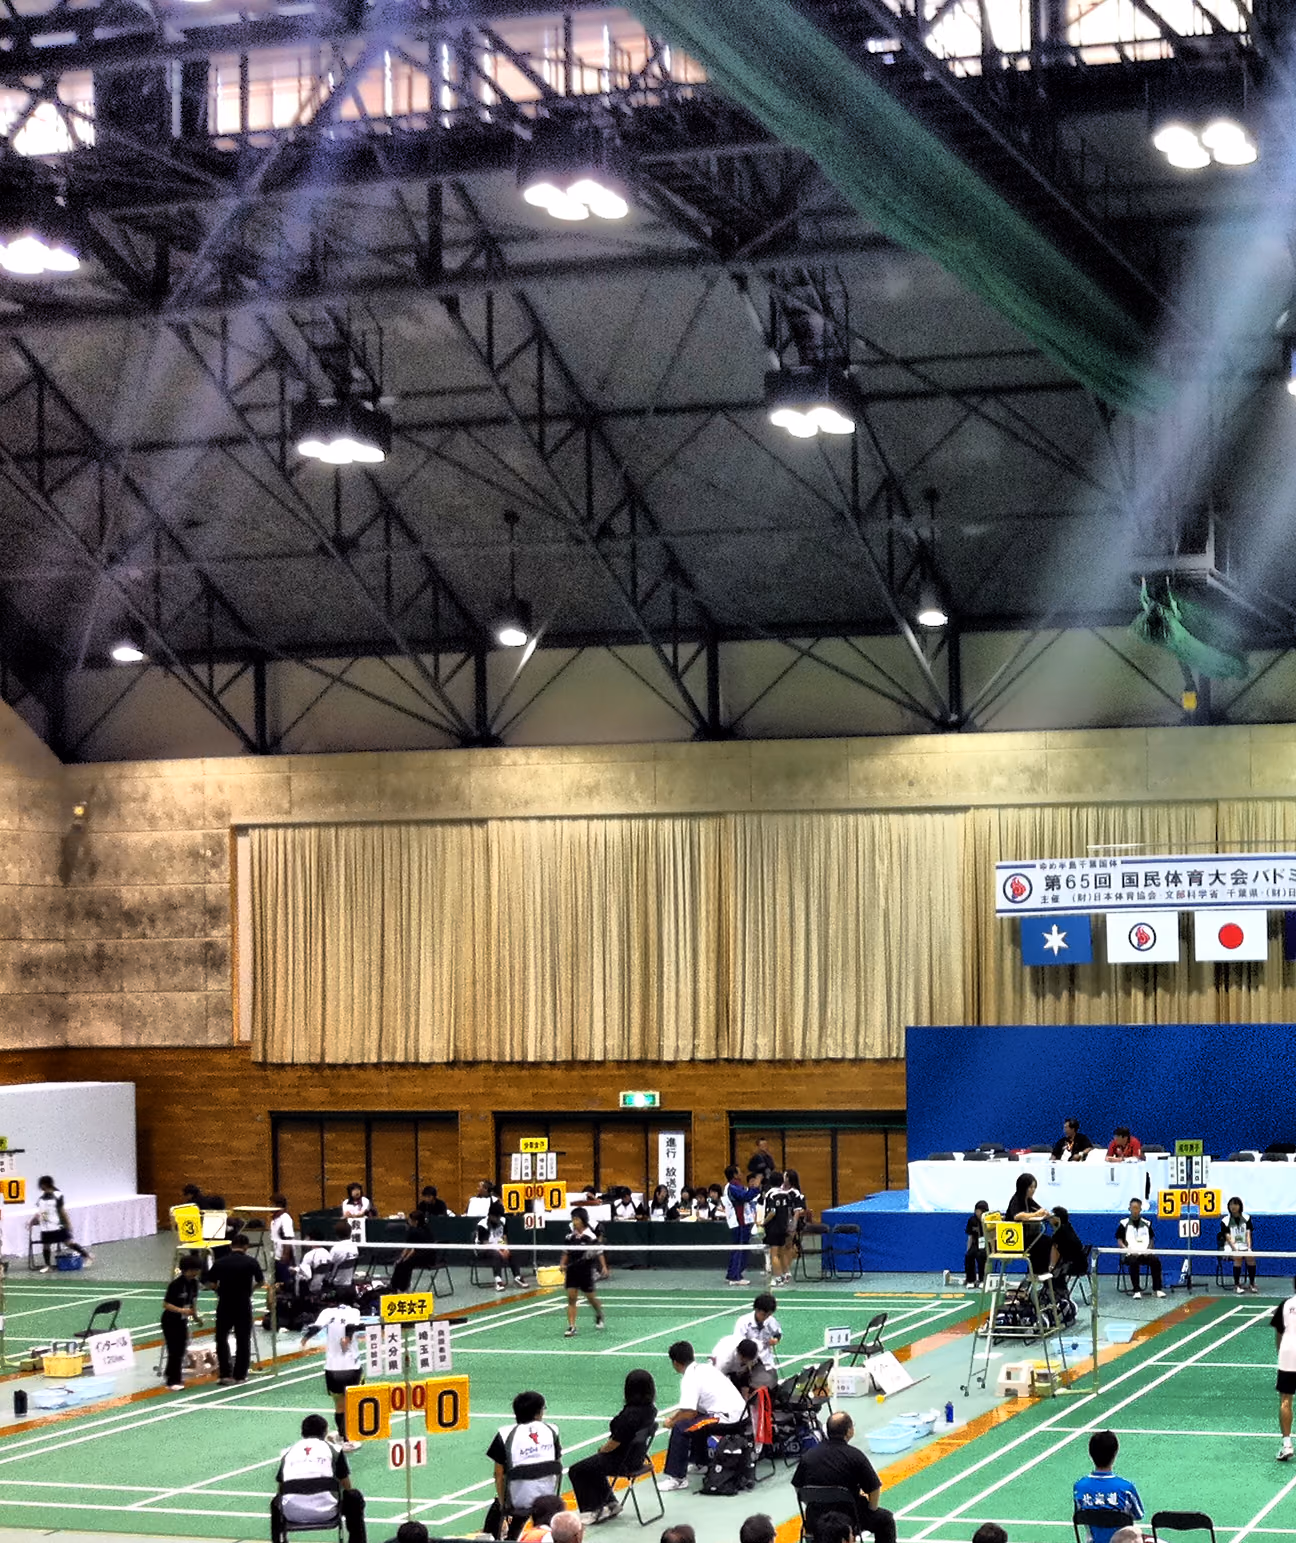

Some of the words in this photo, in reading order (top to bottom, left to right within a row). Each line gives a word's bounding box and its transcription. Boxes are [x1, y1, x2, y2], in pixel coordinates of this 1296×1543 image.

[1163, 1192, 1175, 1214] 5
[1204, 1191, 1215, 1213] 3
[387, 1299, 427, 1316] 少年女子
[388, 1333, 398, 1370] 大分県
[419, 1331, 430, 1368] 埼玉県
[358, 1396, 380, 1436] 0
[437, 1389, 460, 1428] 0
